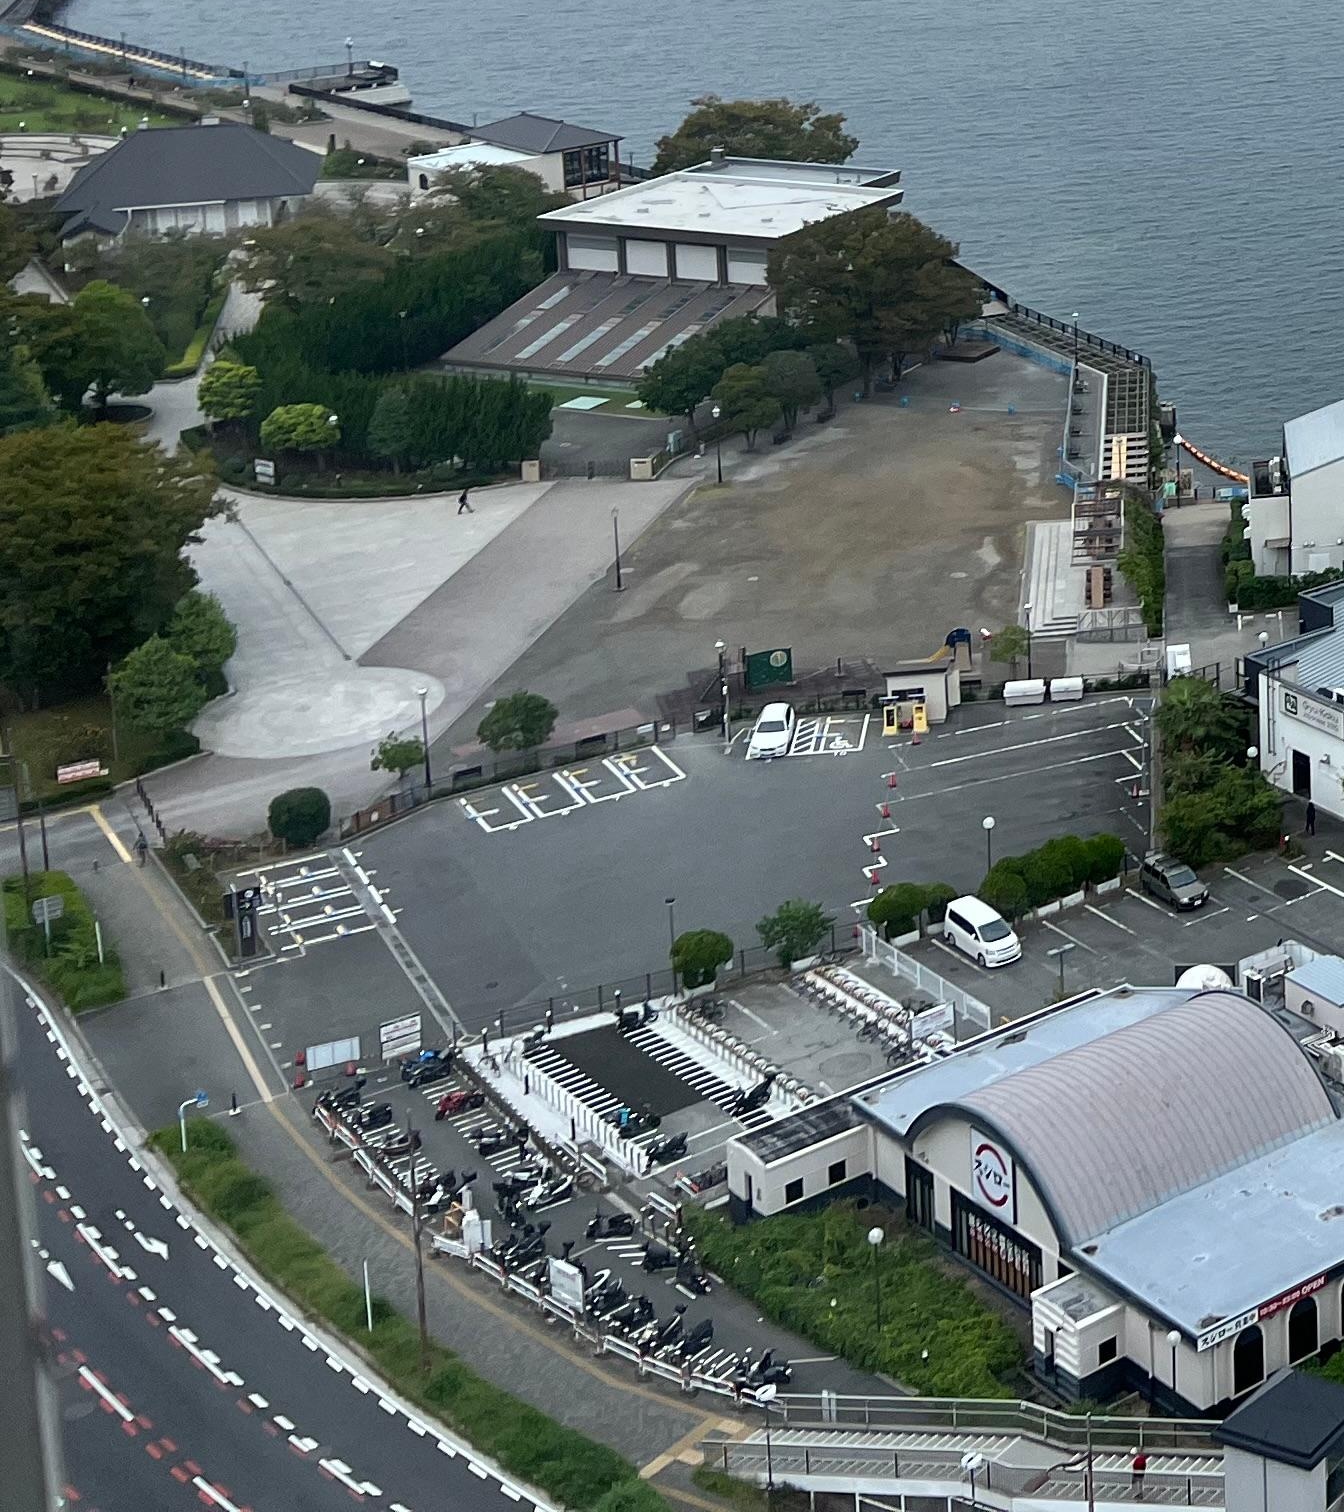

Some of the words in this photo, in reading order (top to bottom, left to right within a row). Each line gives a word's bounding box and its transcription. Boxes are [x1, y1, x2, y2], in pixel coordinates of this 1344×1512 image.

[973, 1159, 1010, 1189] スシロー
[1301, 1275, 1325, 1295] OPEN
